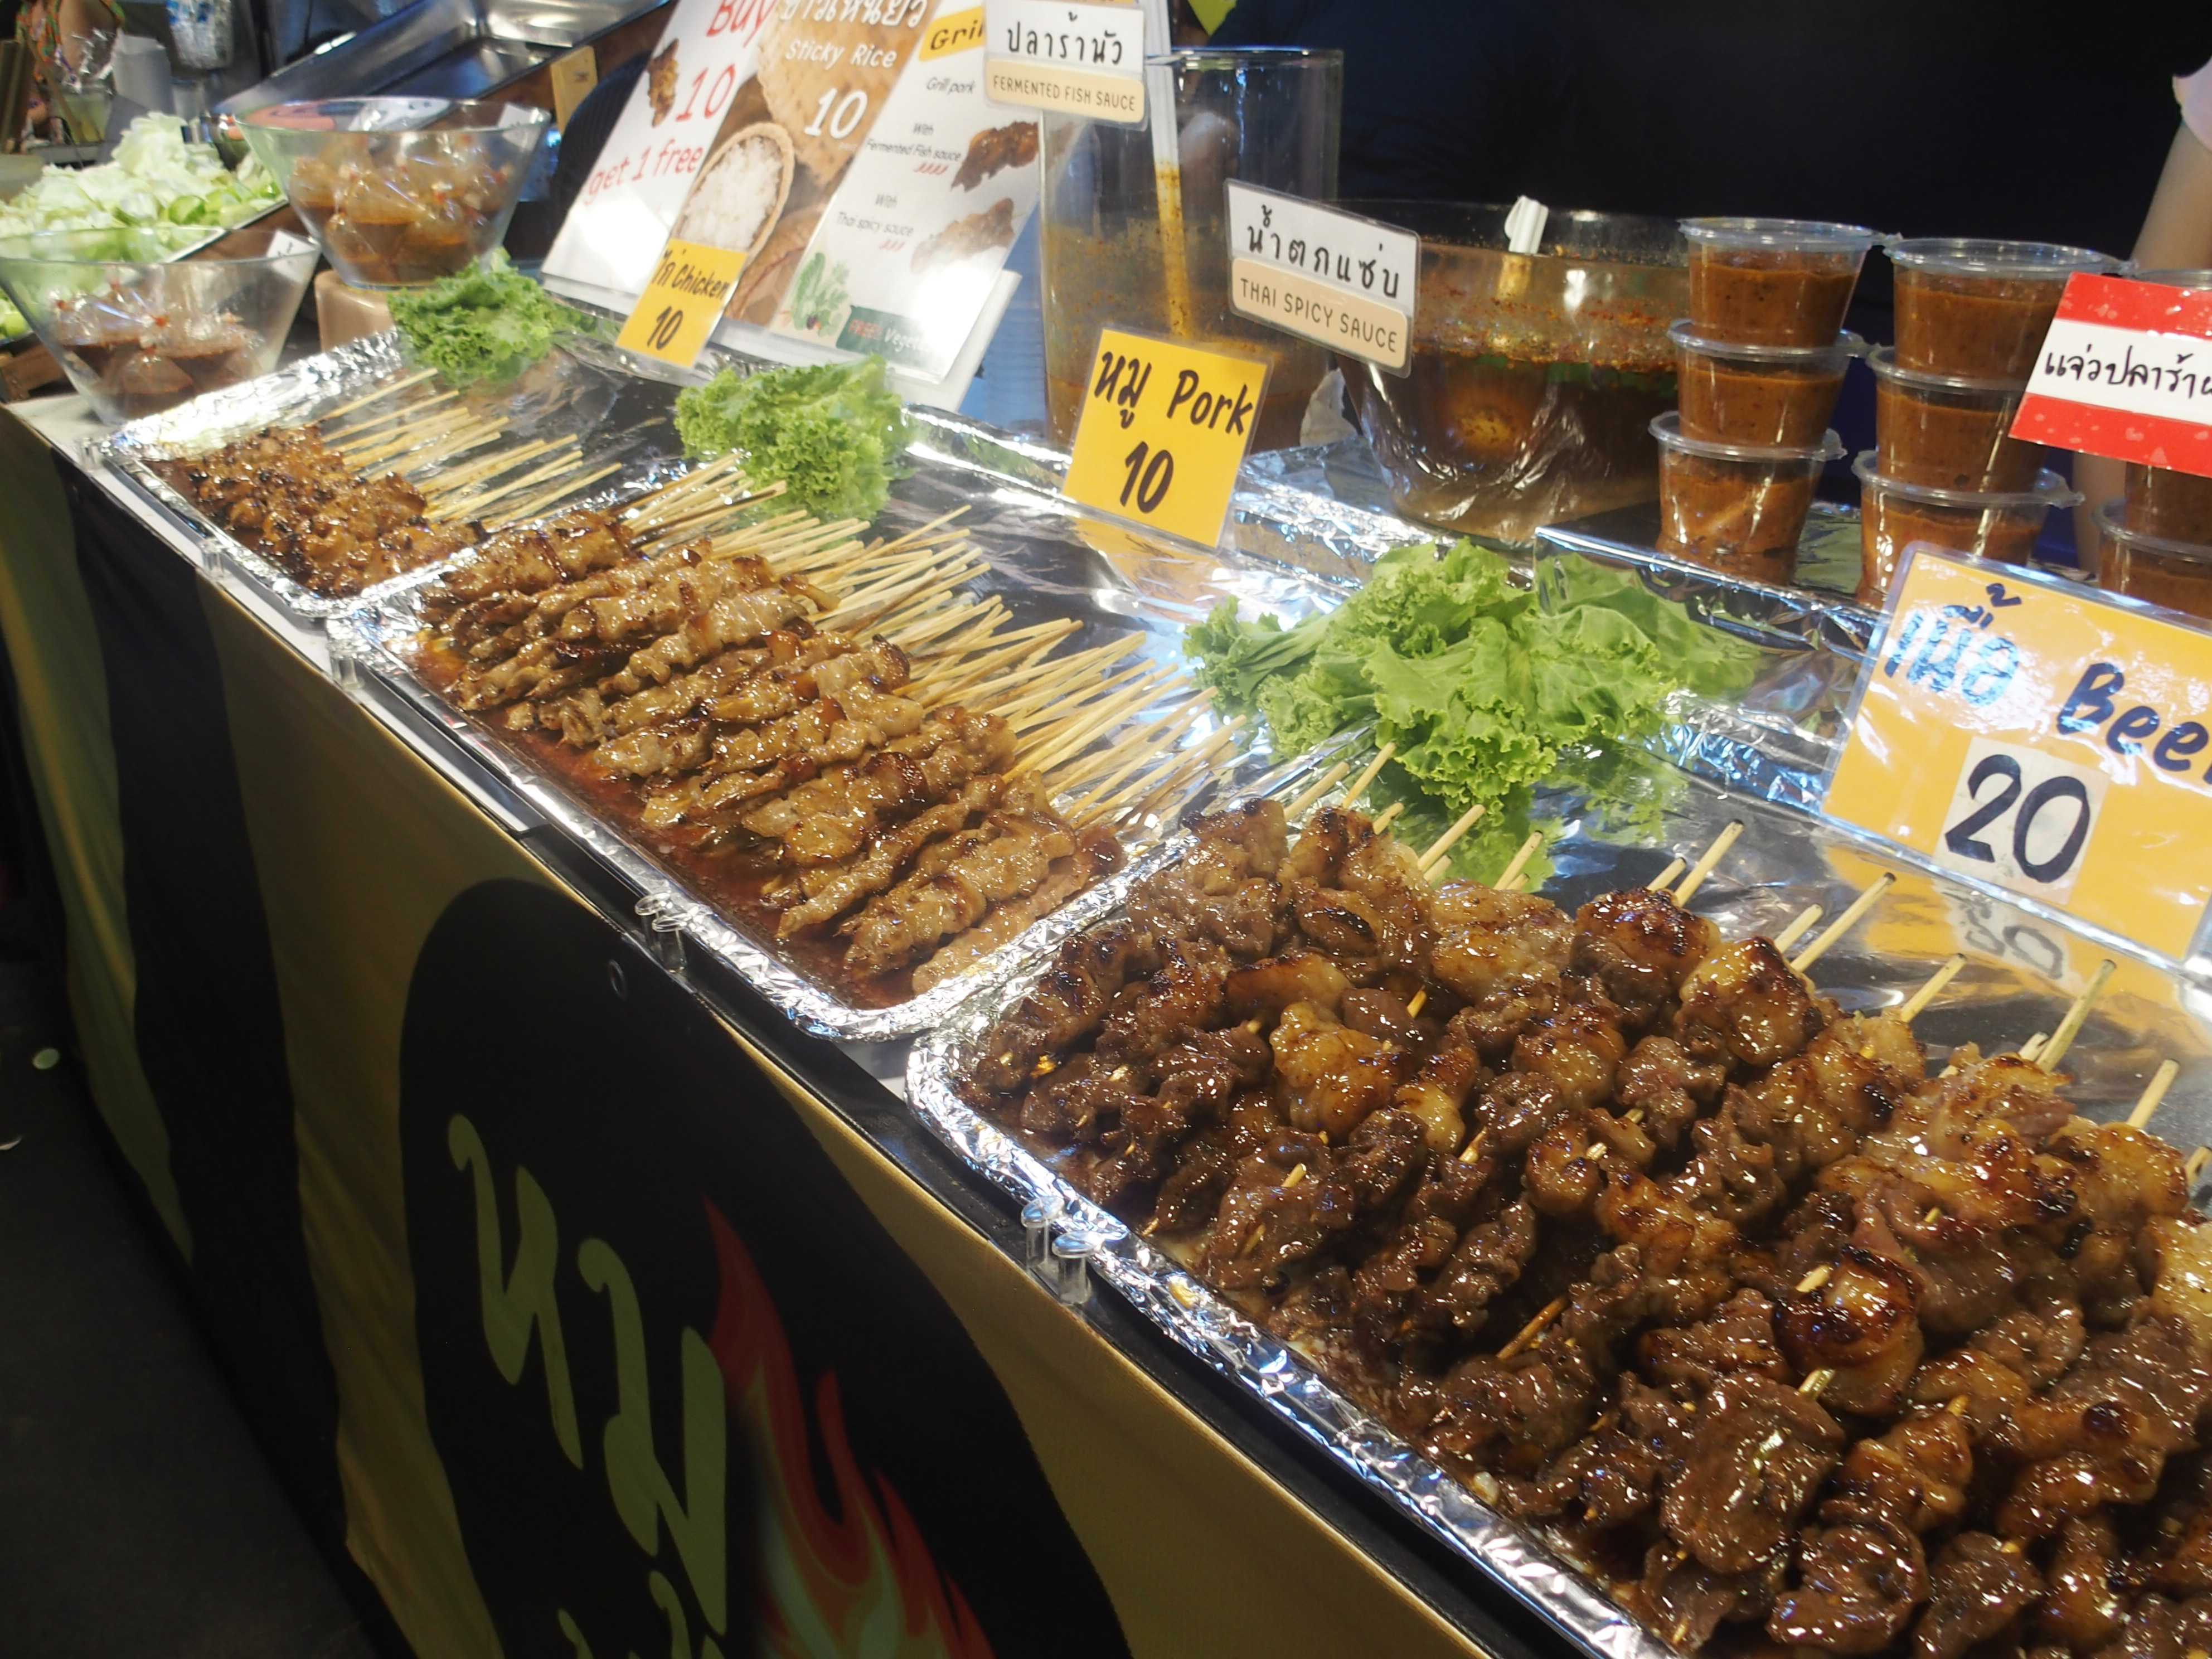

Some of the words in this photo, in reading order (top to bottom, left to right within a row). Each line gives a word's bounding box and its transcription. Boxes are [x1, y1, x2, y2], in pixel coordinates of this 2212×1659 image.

[706, 0, 777, 48] Buy
[785, 39, 845, 70] Sticky
[850, 43, 897, 68] Rice
[675, 64, 736, 122] 10
[804, 88, 868, 139] 10
[993, 75, 1060, 100] FERMENTED
[1065, 86, 1092, 105] FISH
[1096, 91, 1136, 111] SAUCE
[584, 156, 630, 207] get
[632, 145, 651, 182] 1
[653, 138, 704, 174] free
[671, 263, 731, 301] Chicken
[647, 305, 683, 351] 10
[1240, 277, 1277, 308] THAI
[1283, 293, 1333, 328] SPICY
[1339, 313, 1398, 353] SAUCE
[1094, 351, 1152, 429] หมู
[1166, 369, 1253, 436] Pork
[1119, 441, 1174, 514] 10
[2057, 662, 2212, 787] Bee
[1944, 754, 2092, 884] 20
